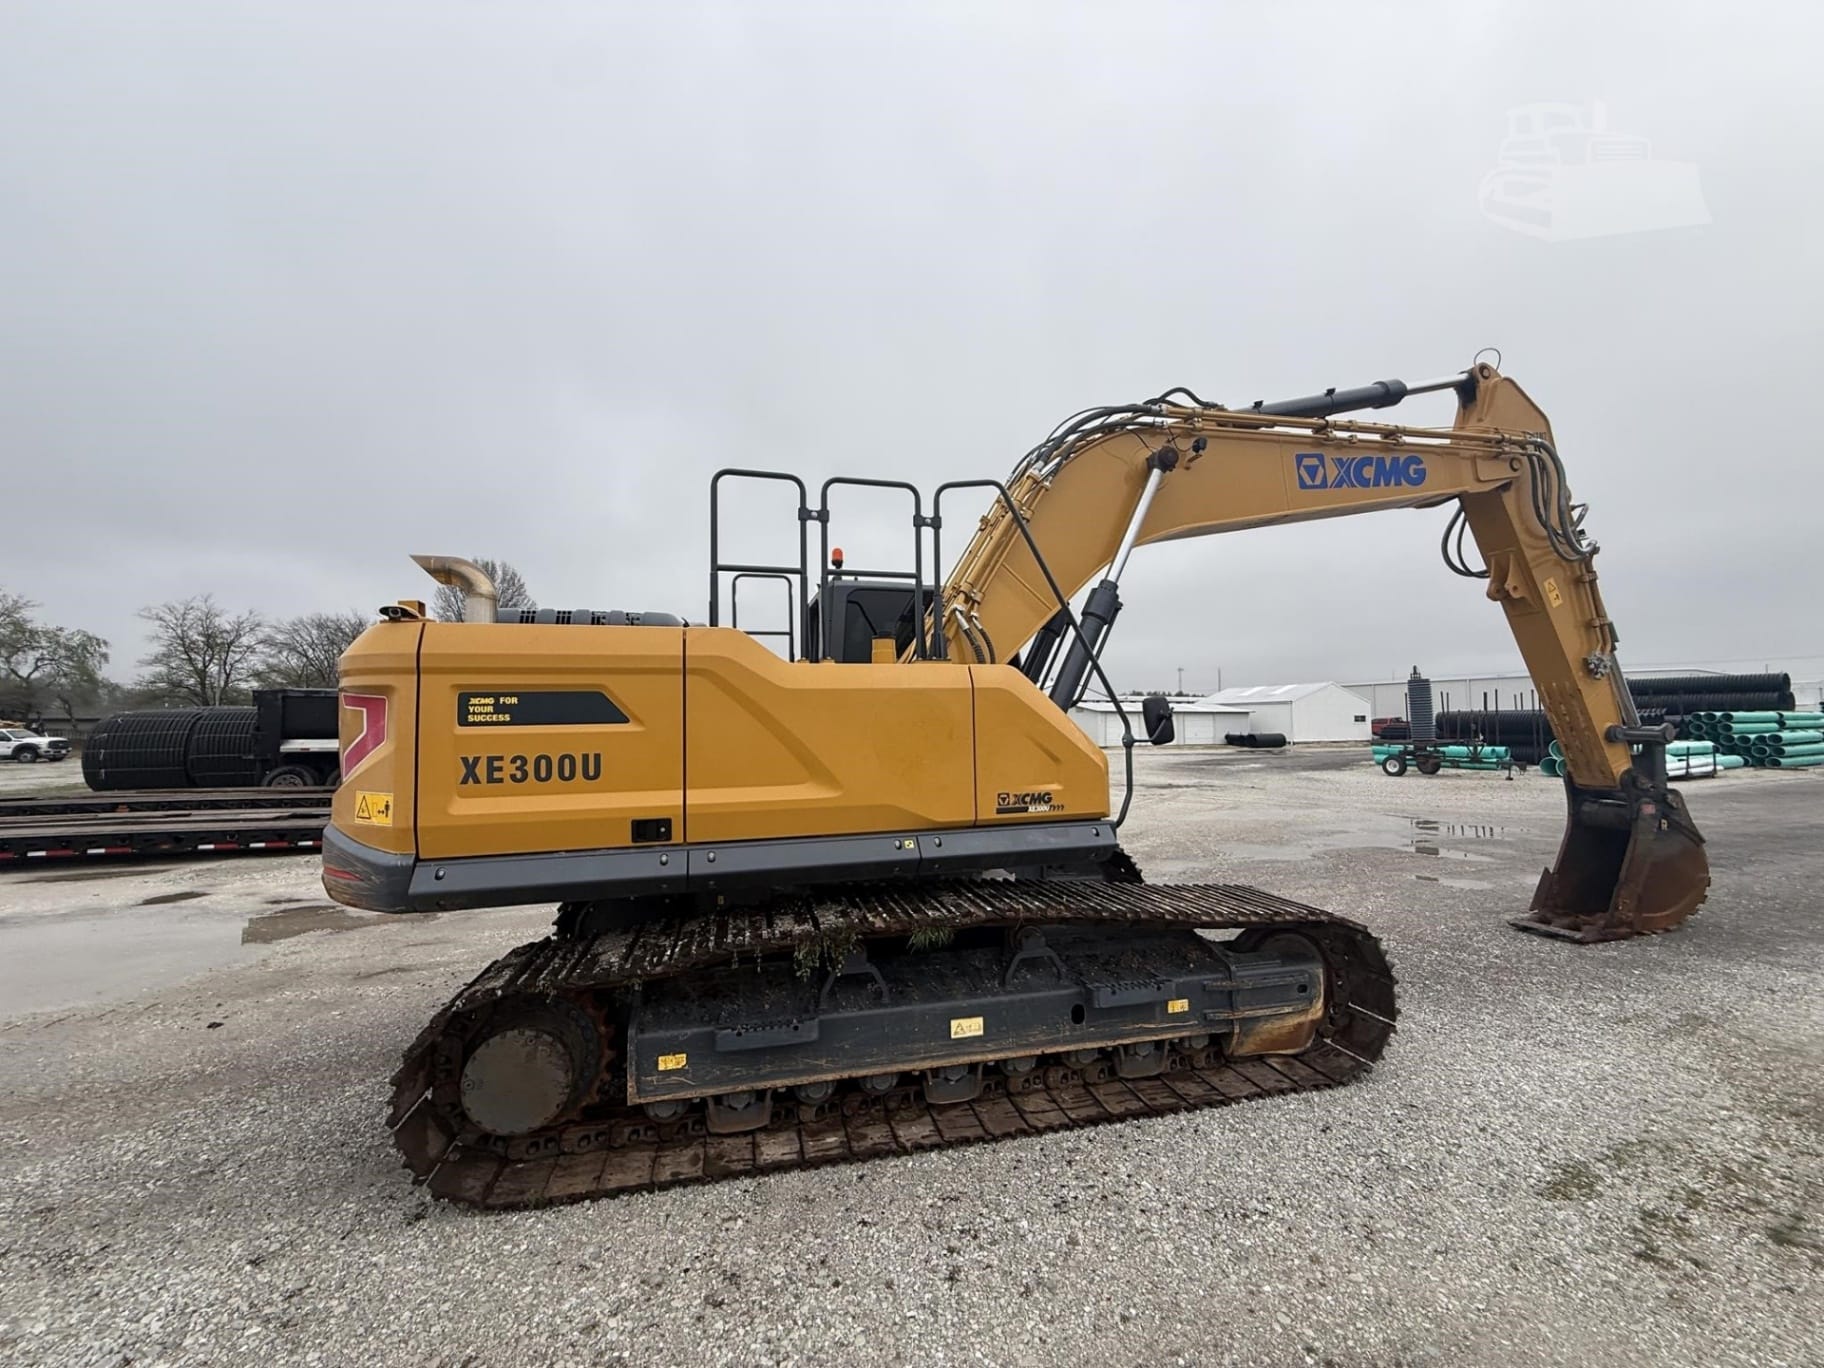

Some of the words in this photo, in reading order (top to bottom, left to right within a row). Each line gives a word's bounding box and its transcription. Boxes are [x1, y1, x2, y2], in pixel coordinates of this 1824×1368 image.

[1329, 455, 1427, 488] XCMG
[499, 696, 518, 704] FOR
[468, 705, 494, 713] YOUR
[467, 713, 511, 722] SUCCESS
[459, 753, 602, 785] XE300U
[1011, 792, 1053, 806] XCMG
